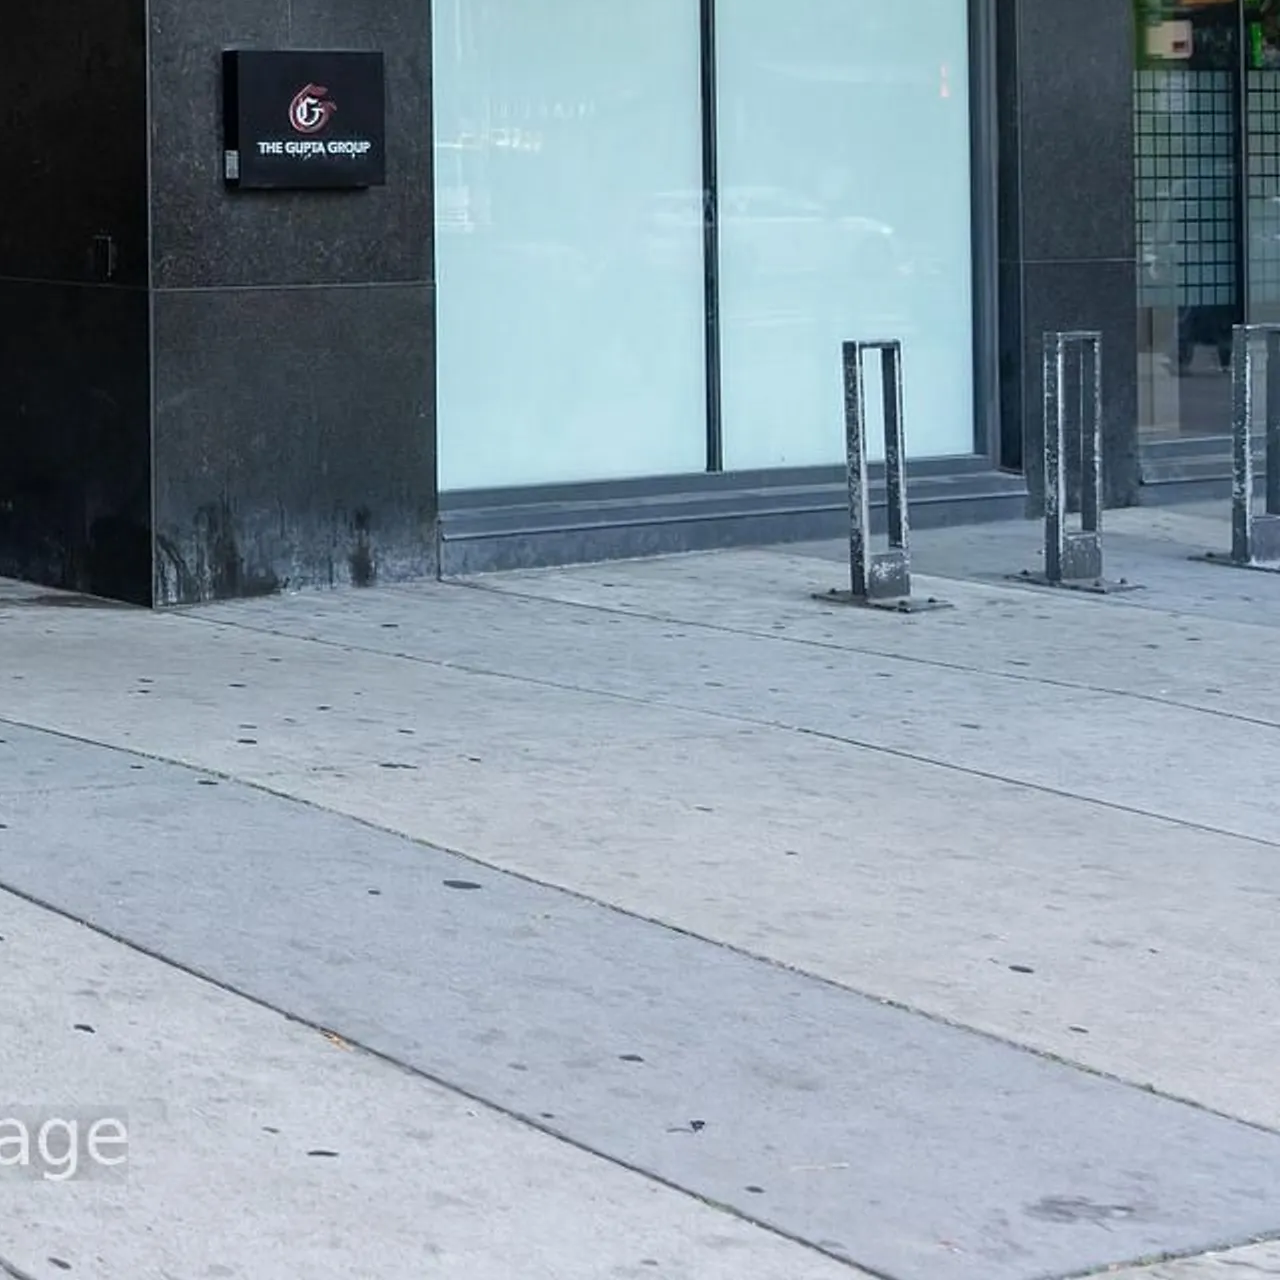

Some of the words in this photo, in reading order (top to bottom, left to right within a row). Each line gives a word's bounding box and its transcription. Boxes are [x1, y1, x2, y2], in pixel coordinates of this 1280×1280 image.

[257, 142, 283, 154] THE
[285, 141, 325, 154] GUPTA
[327, 141, 371, 154] GROUP
